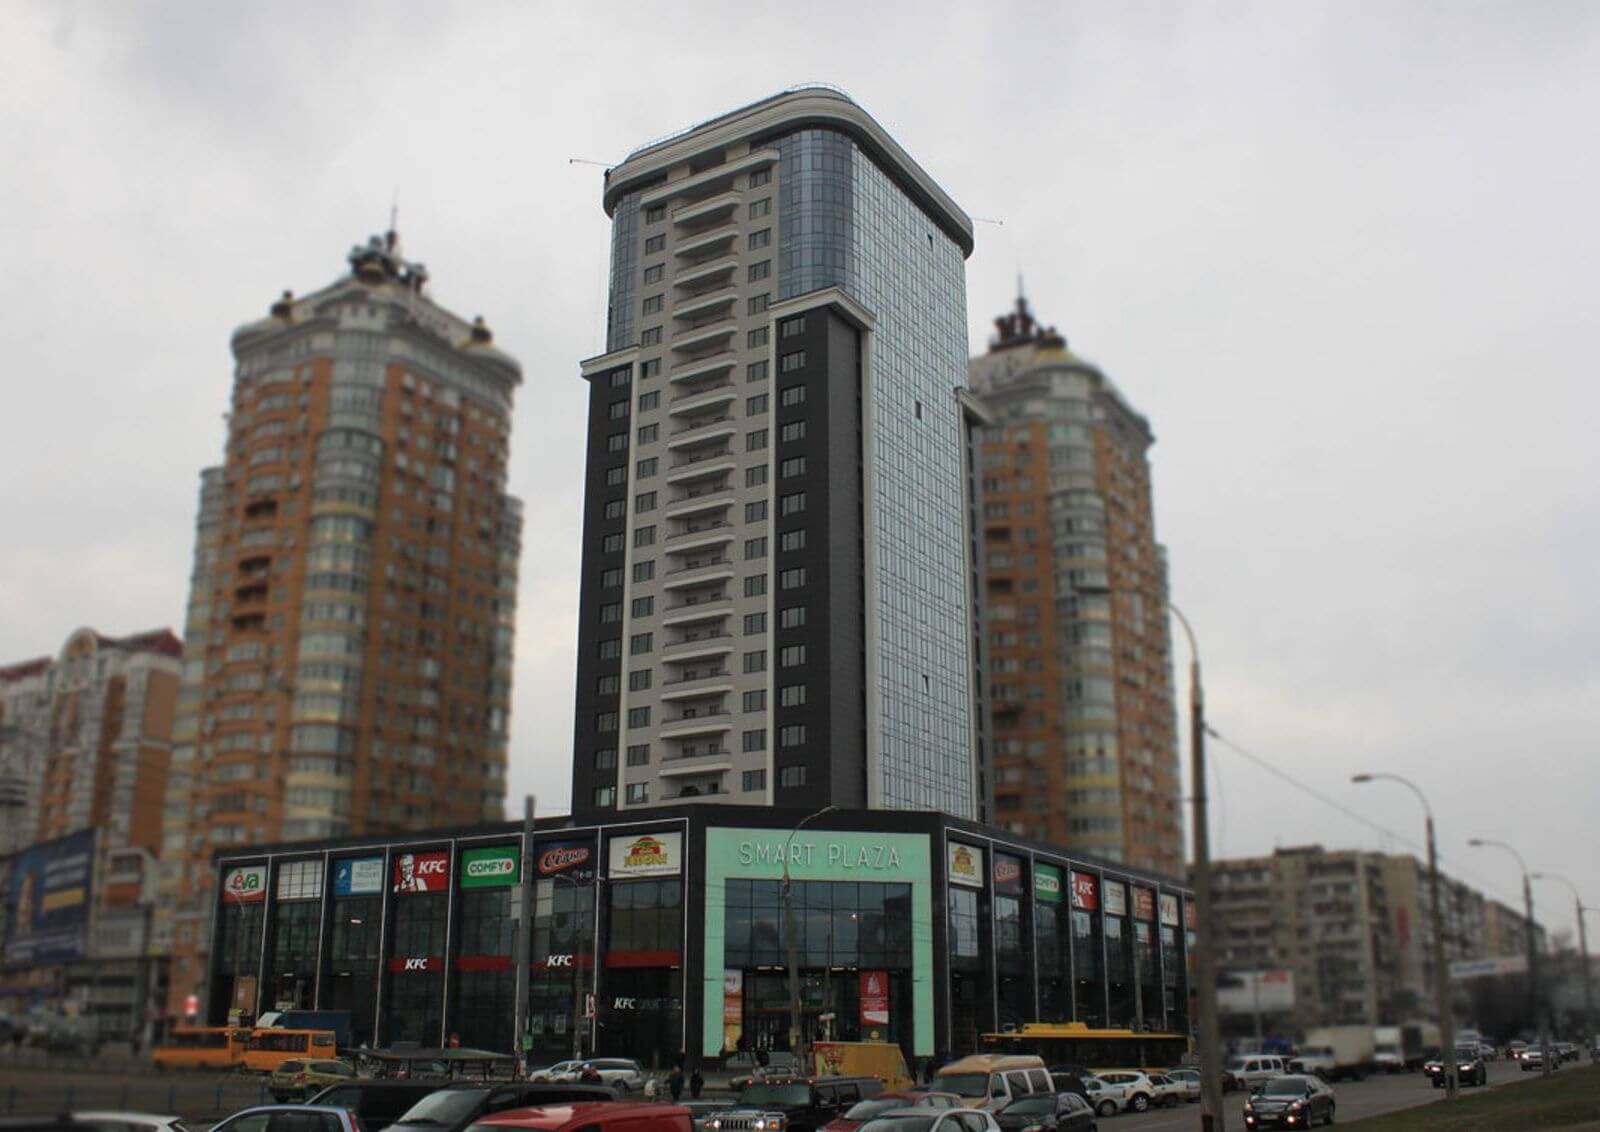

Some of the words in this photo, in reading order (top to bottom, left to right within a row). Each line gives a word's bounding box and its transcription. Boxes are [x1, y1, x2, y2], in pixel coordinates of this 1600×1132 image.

[739, 842, 816, 865] SMART
[828, 844, 901, 868] PLAZA
[417, 859, 447, 873] KFC
[470, 861, 505, 874] COMFY
[1078, 879, 1093, 895] KFC
[404, 958, 428, 970] KFC
[547, 955, 573, 967] KFC
[613, 997, 637, 1009] KFC
